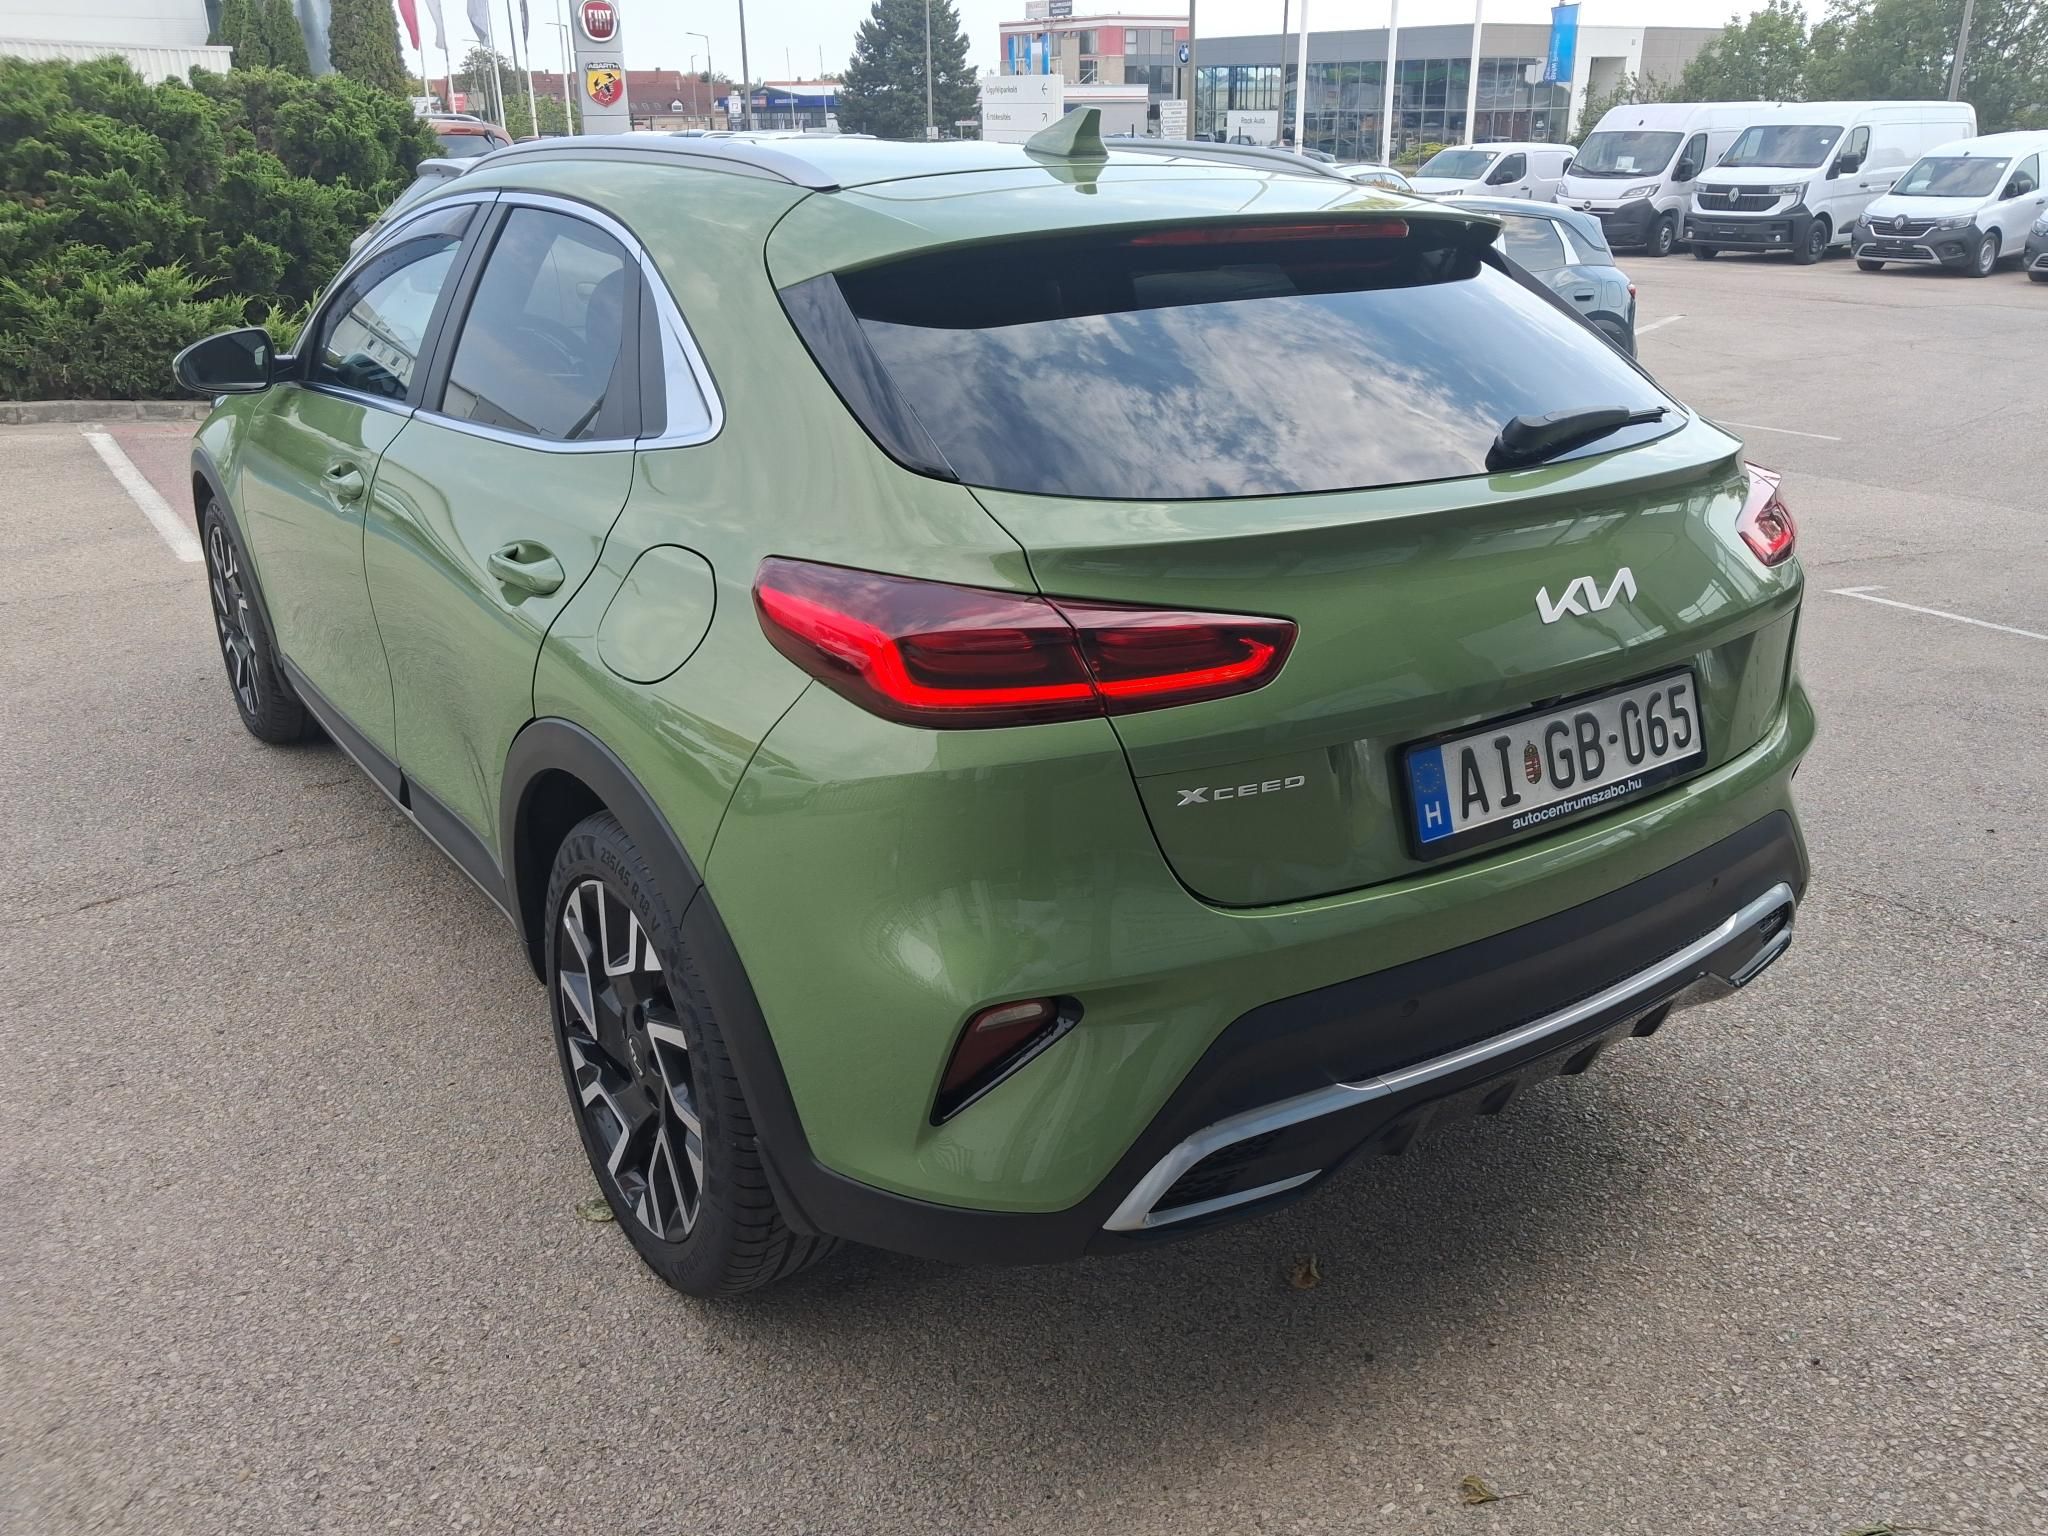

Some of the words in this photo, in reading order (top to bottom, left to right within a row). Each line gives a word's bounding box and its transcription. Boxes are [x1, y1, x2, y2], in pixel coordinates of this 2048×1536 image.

[588, 9, 612, 31] FIAT
[587, 62, 619, 70] ABARTH
[1535, 566, 1638, 625] KIA
[1176, 774, 1306, 807] XCEED
[1461, 735, 1522, 820] AI
[1424, 800, 1443, 829] H
[1511, 776, 1643, 830] autocentrumszabo.hu
[600, 847, 631, 887] 235/45
[631, 881, 640, 900] R
